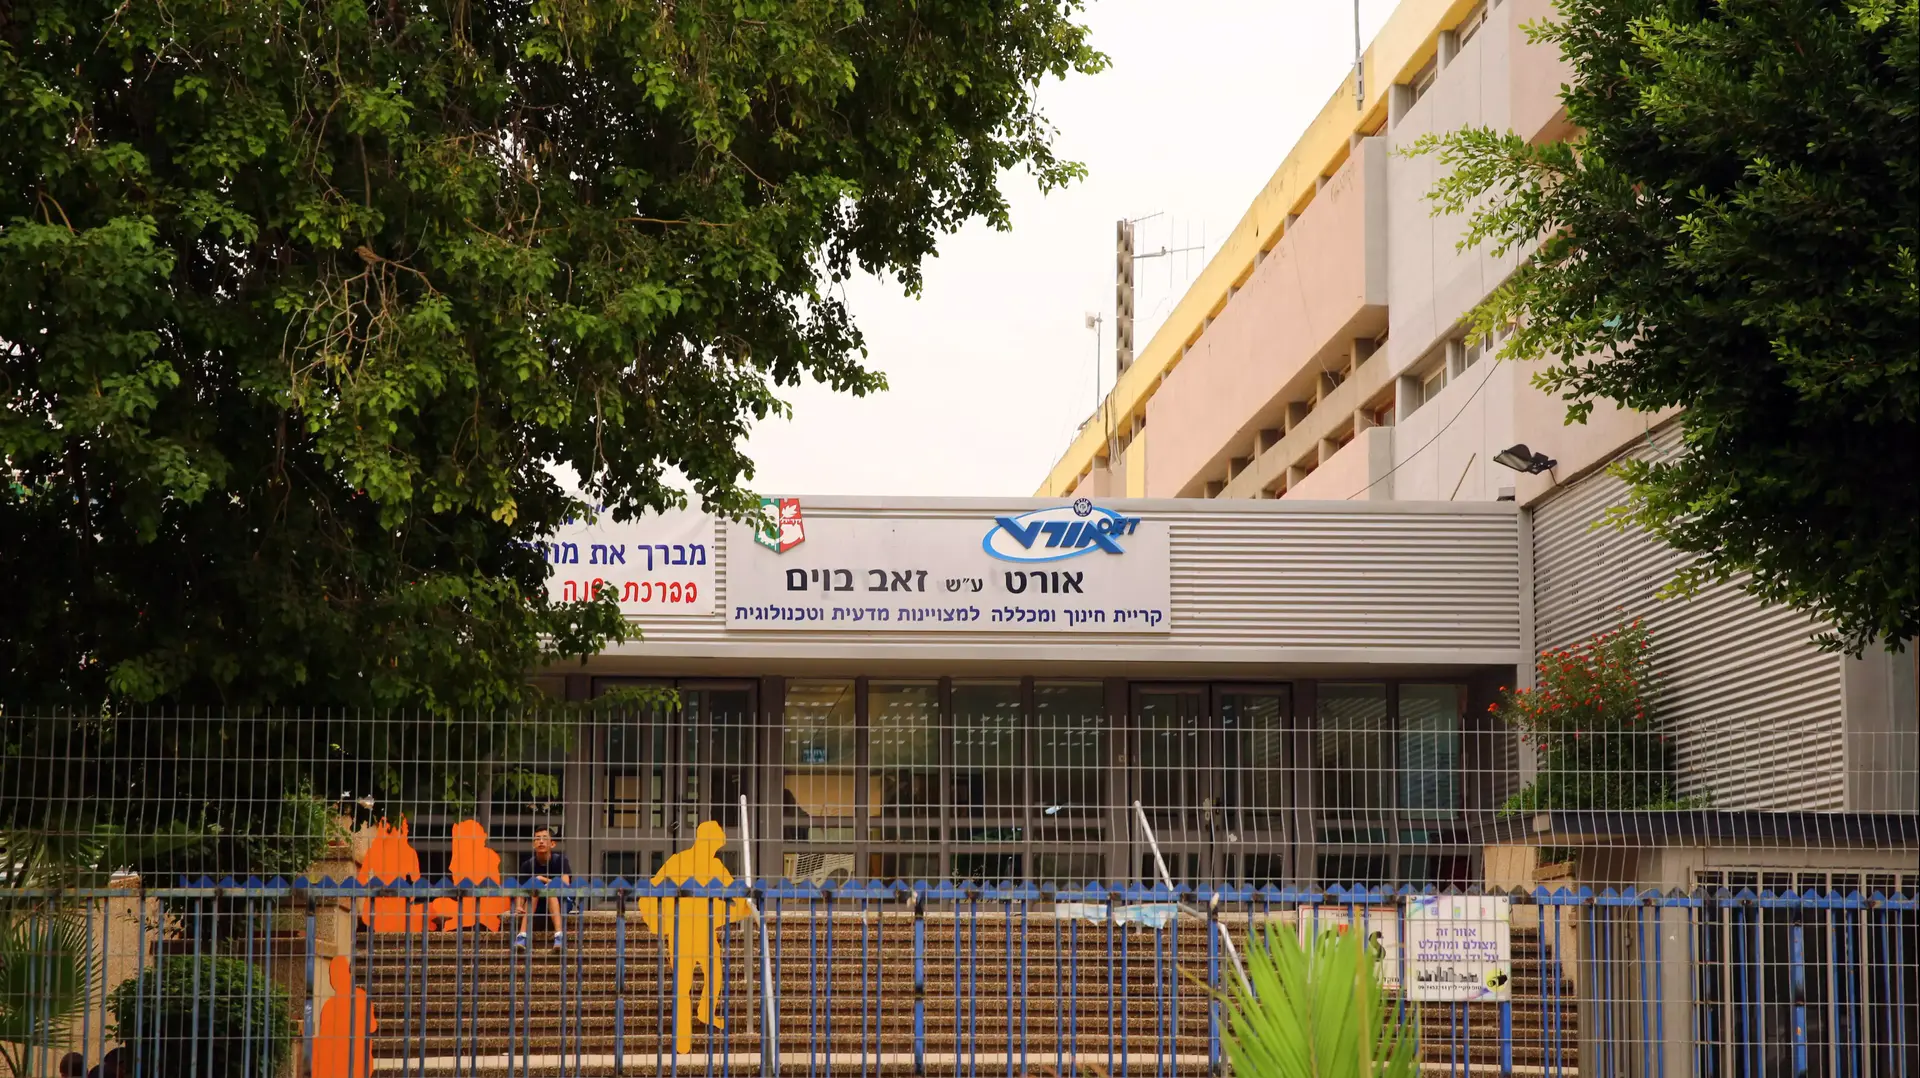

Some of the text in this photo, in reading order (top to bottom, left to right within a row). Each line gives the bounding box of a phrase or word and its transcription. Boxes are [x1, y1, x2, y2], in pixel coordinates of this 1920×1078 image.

[589, 544, 626, 565] את
[637, 543, 707, 571] מברך
[786, 569, 854, 592] בוים
[869, 569, 928, 592] זאב
[1005, 571, 1084, 594] אורט
[621, 581, 697, 603] בברכת
[735, 604, 1162, 626] קריית חינוך ומכללה למצויינות מדעית וטכנולוגית
[1436, 928, 1448, 936] זה
[1418, 939, 1497, 952] מצולם ומוקלט
